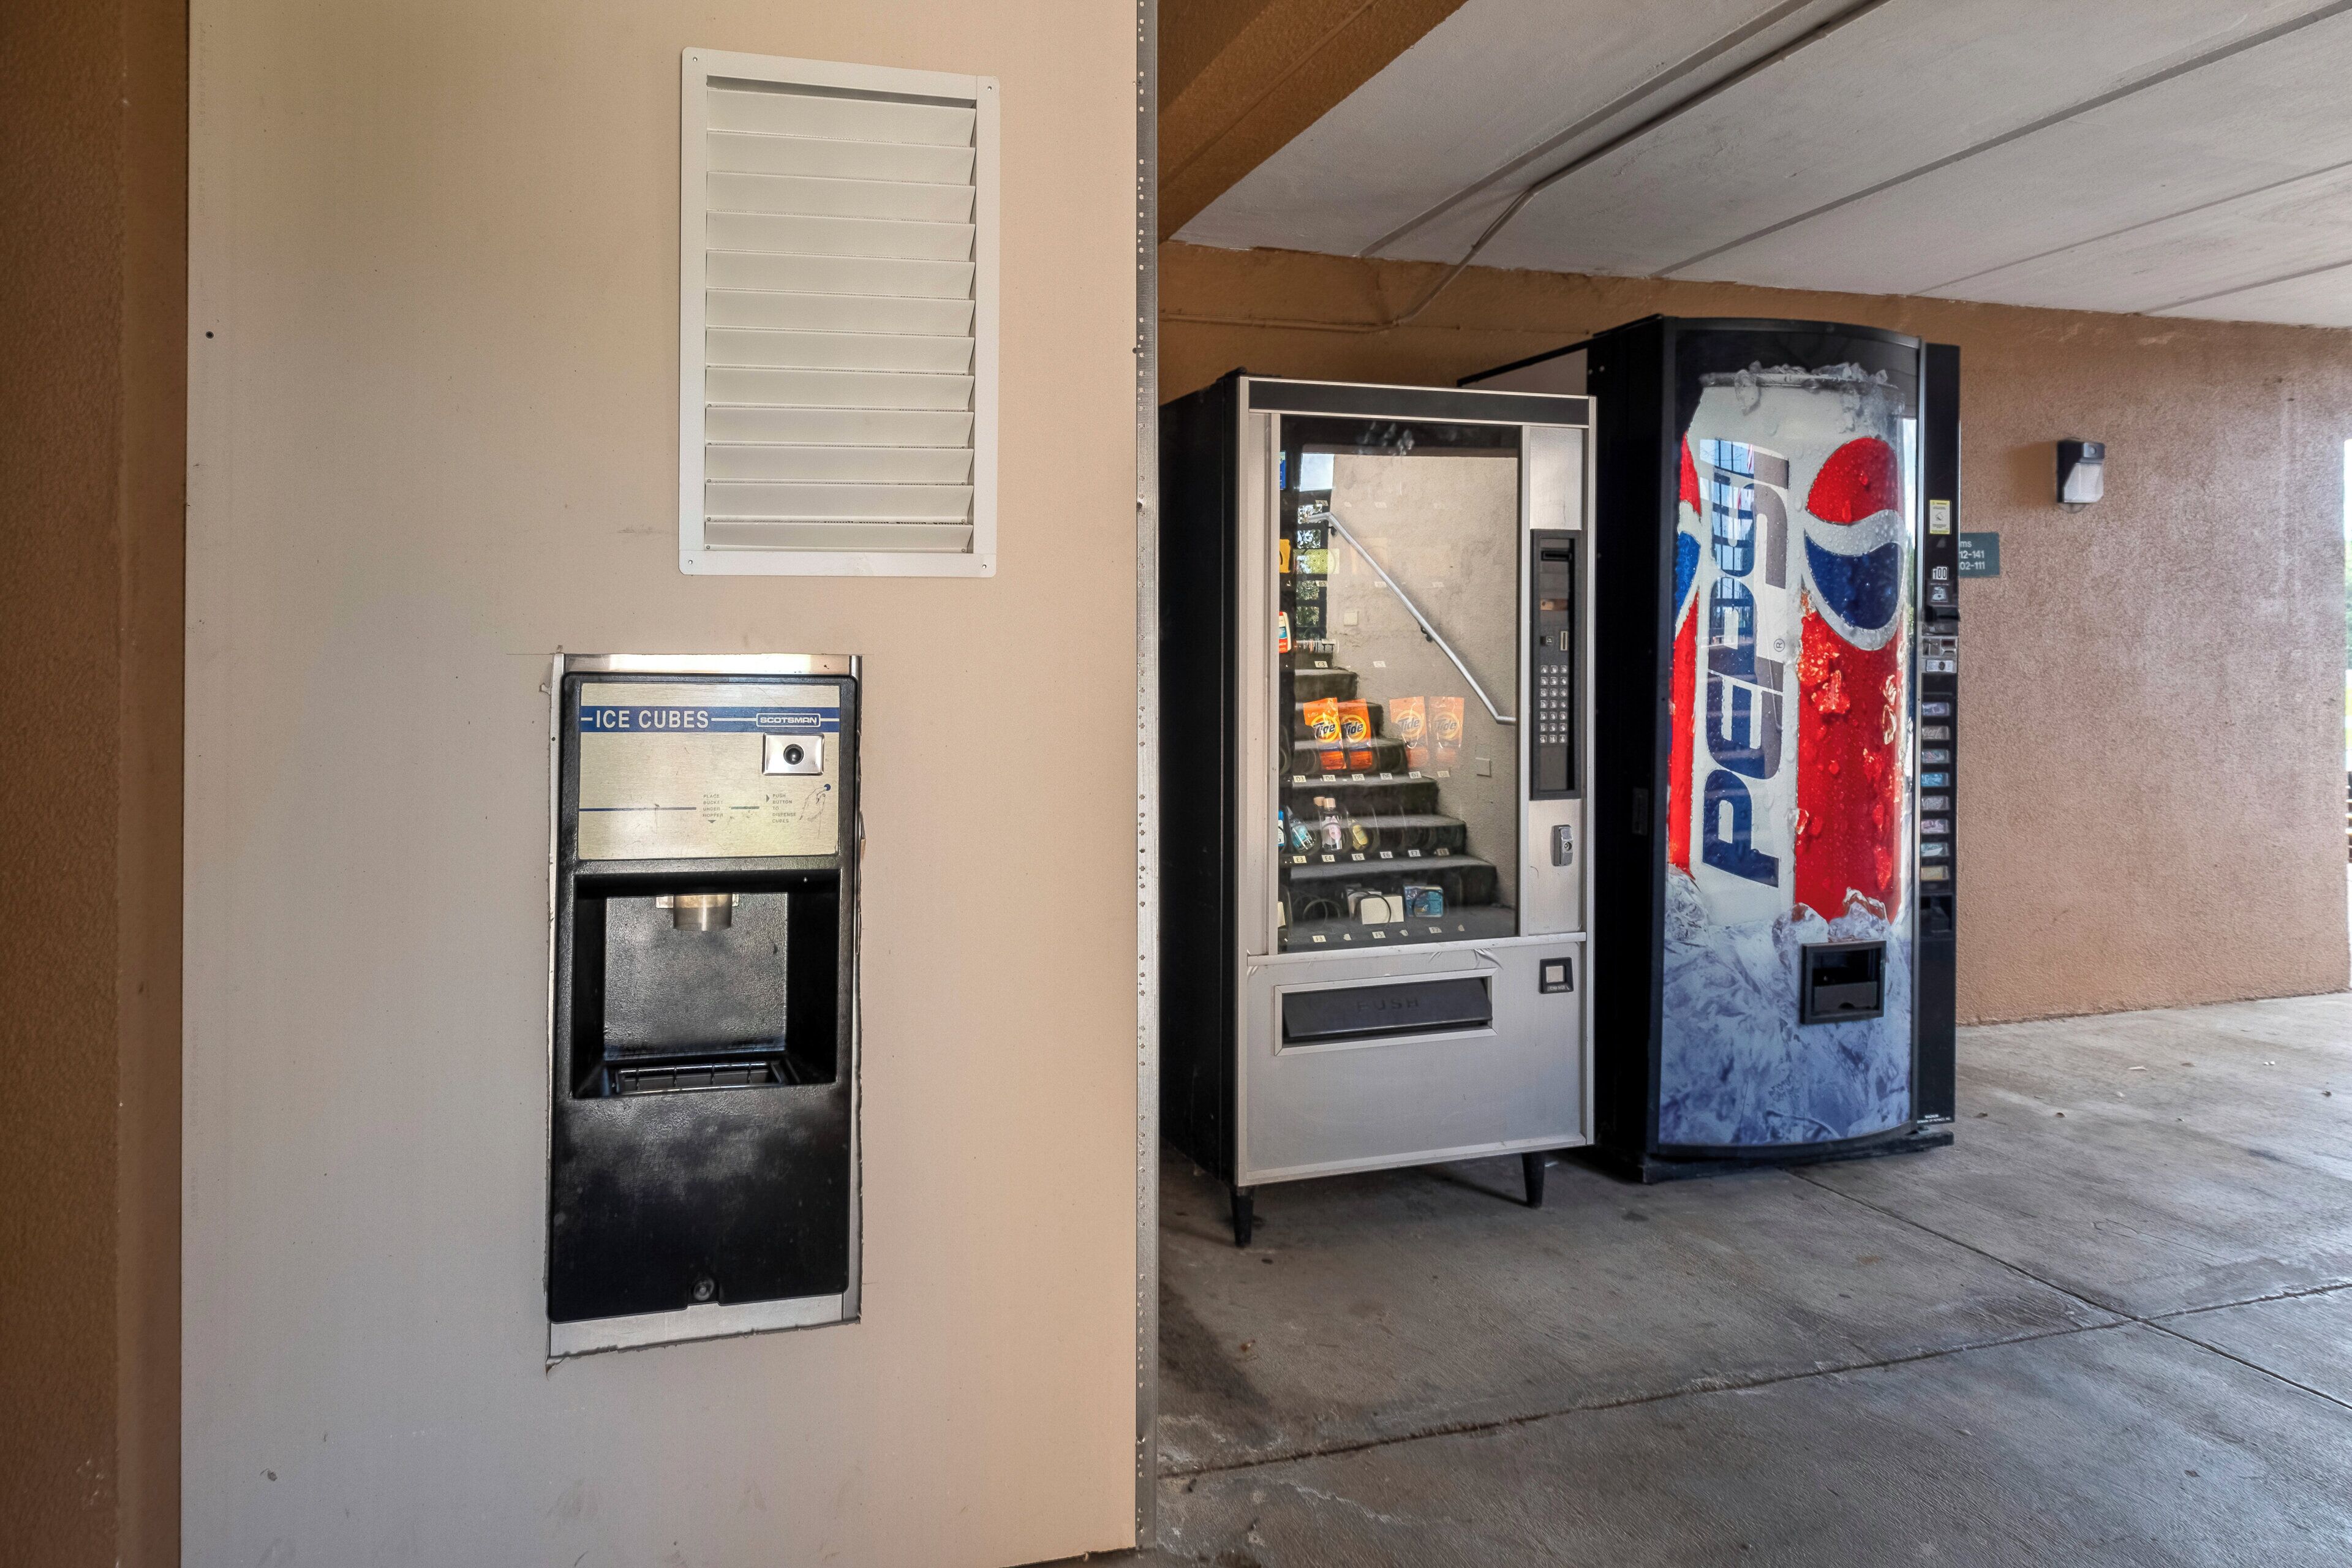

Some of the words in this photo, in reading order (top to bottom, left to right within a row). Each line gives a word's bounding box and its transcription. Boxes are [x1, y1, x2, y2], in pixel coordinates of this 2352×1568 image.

[1959, 550, 1985, 559] 12-141
[1933, 567, 1947, 579] 100
[1959, 561, 1986, 570] 02-111
[1702, 443, 1789, 888] PEPSI
[596, 710, 630, 728] ICE
[638, 709, 709, 728] CUBES
[760, 716, 818, 725] SCOTSMAN
[1397, 717, 1420, 731] Tide
[1435, 718, 1457, 733] Tide
[1313, 721, 1335, 738] Tide
[1341, 721, 1363, 736] Tide
[1357, 997, 1419, 1012] PUSH
